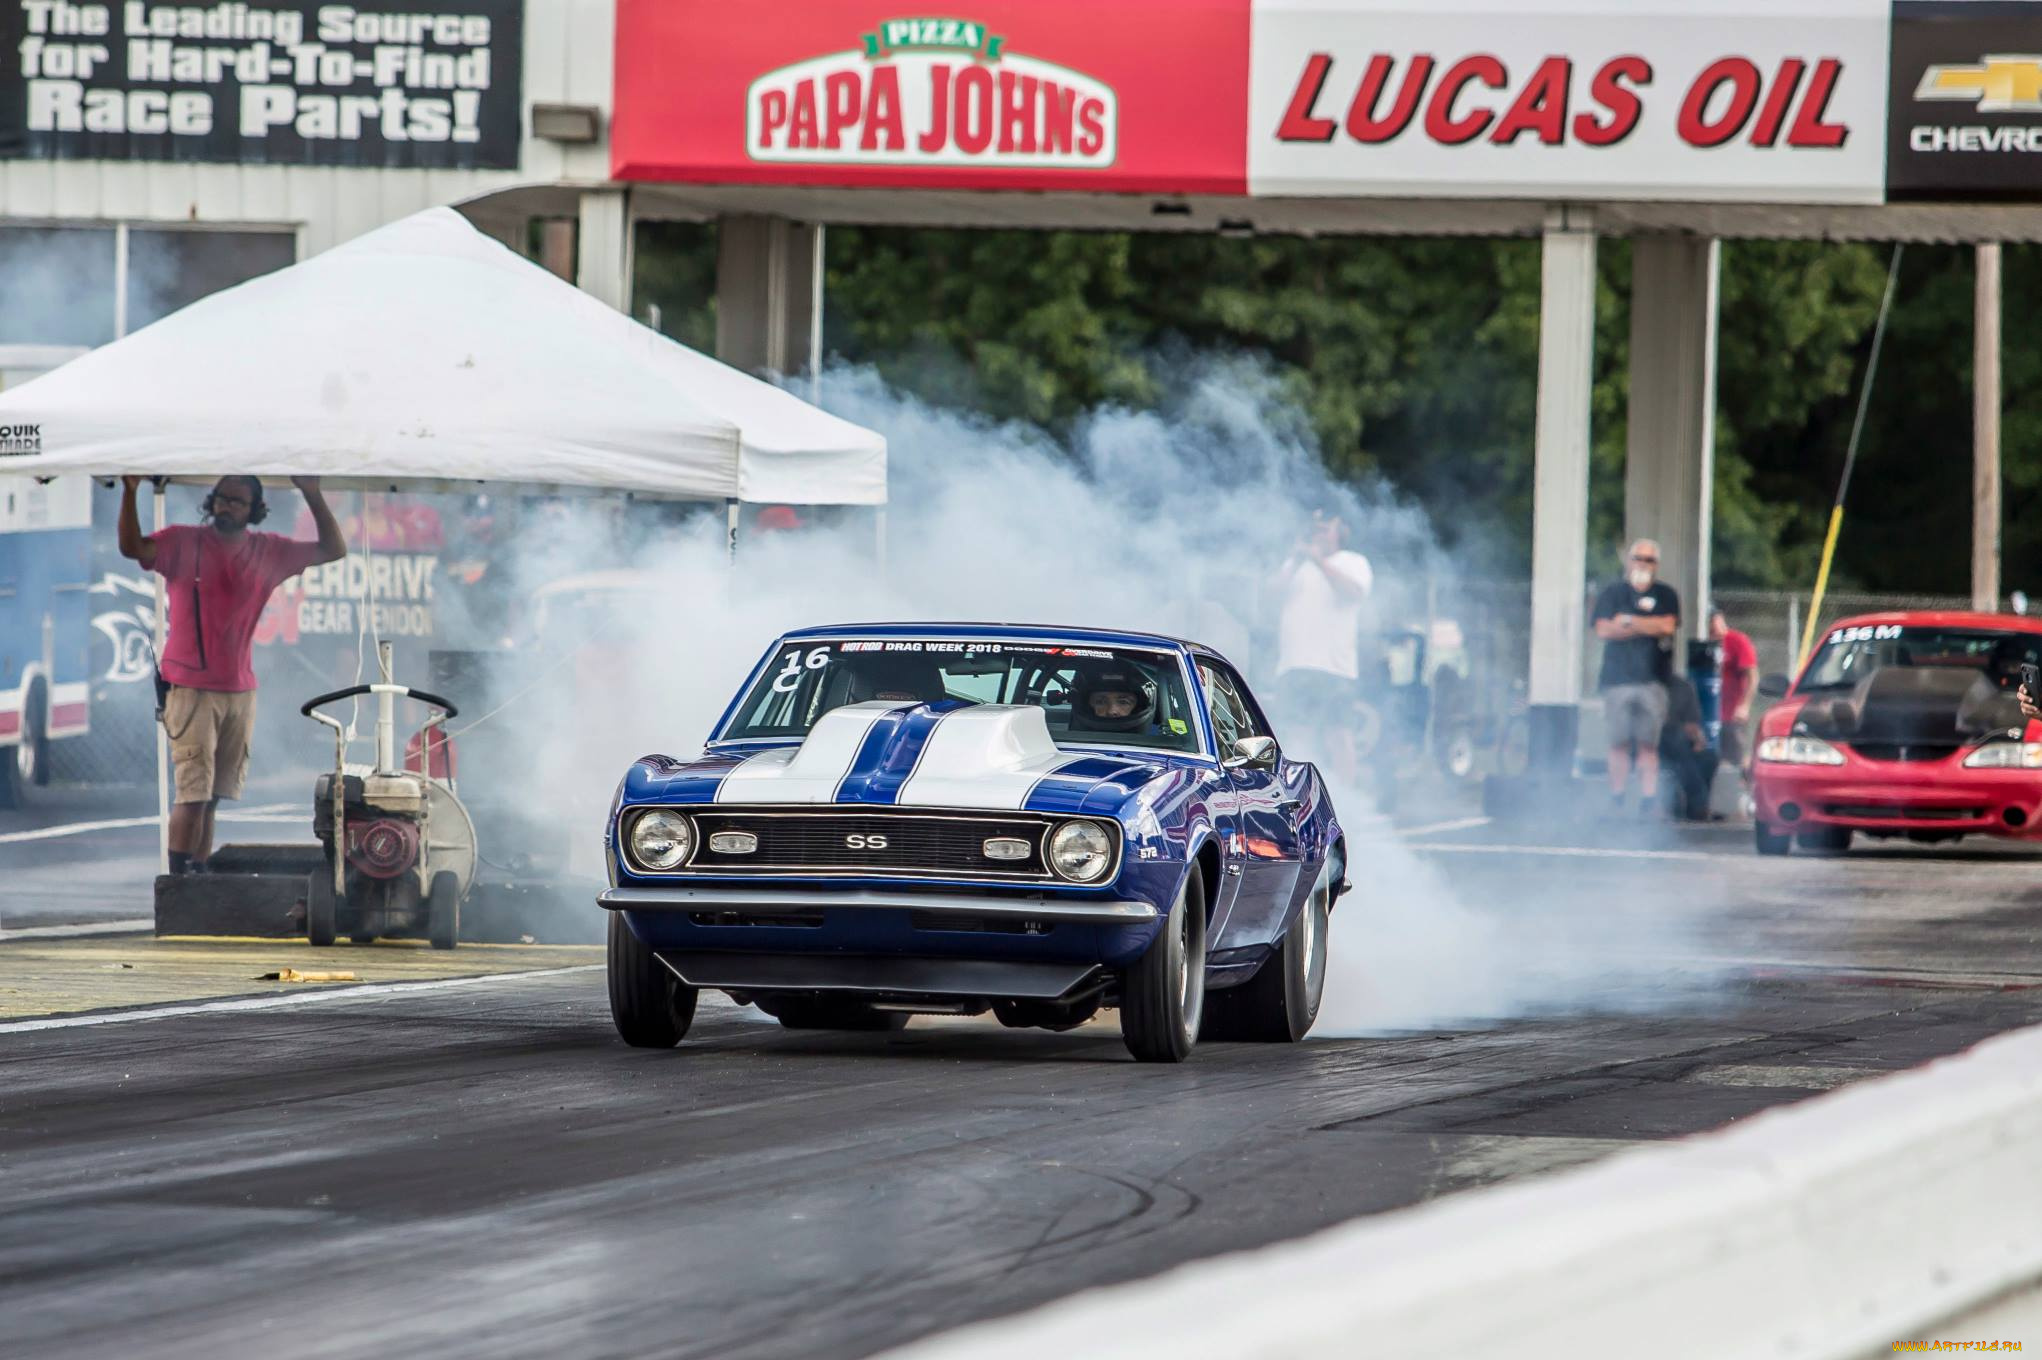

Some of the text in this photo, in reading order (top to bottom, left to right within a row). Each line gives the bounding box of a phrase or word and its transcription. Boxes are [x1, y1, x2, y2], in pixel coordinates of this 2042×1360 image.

[20, 0, 491, 46] The Leading Source
[887, 19, 979, 47] PIZZA
[18, 36, 491, 89] for Hard-To-Find
[27, 79, 482, 142] Race Parts!
[759, 64, 1105, 156] PAPA JOHNS
[1275, 53, 1851, 149] LUCAS OIL
[299, 600, 353, 634] GEAR
[780, 646, 831, 674] 16
[885, 642, 923, 651] DRAG
[925, 643, 965, 652] WEEK
[966, 644, 1002, 653] 2018
[772, 671, 801, 693] C
[846, 834, 888, 849] SS
